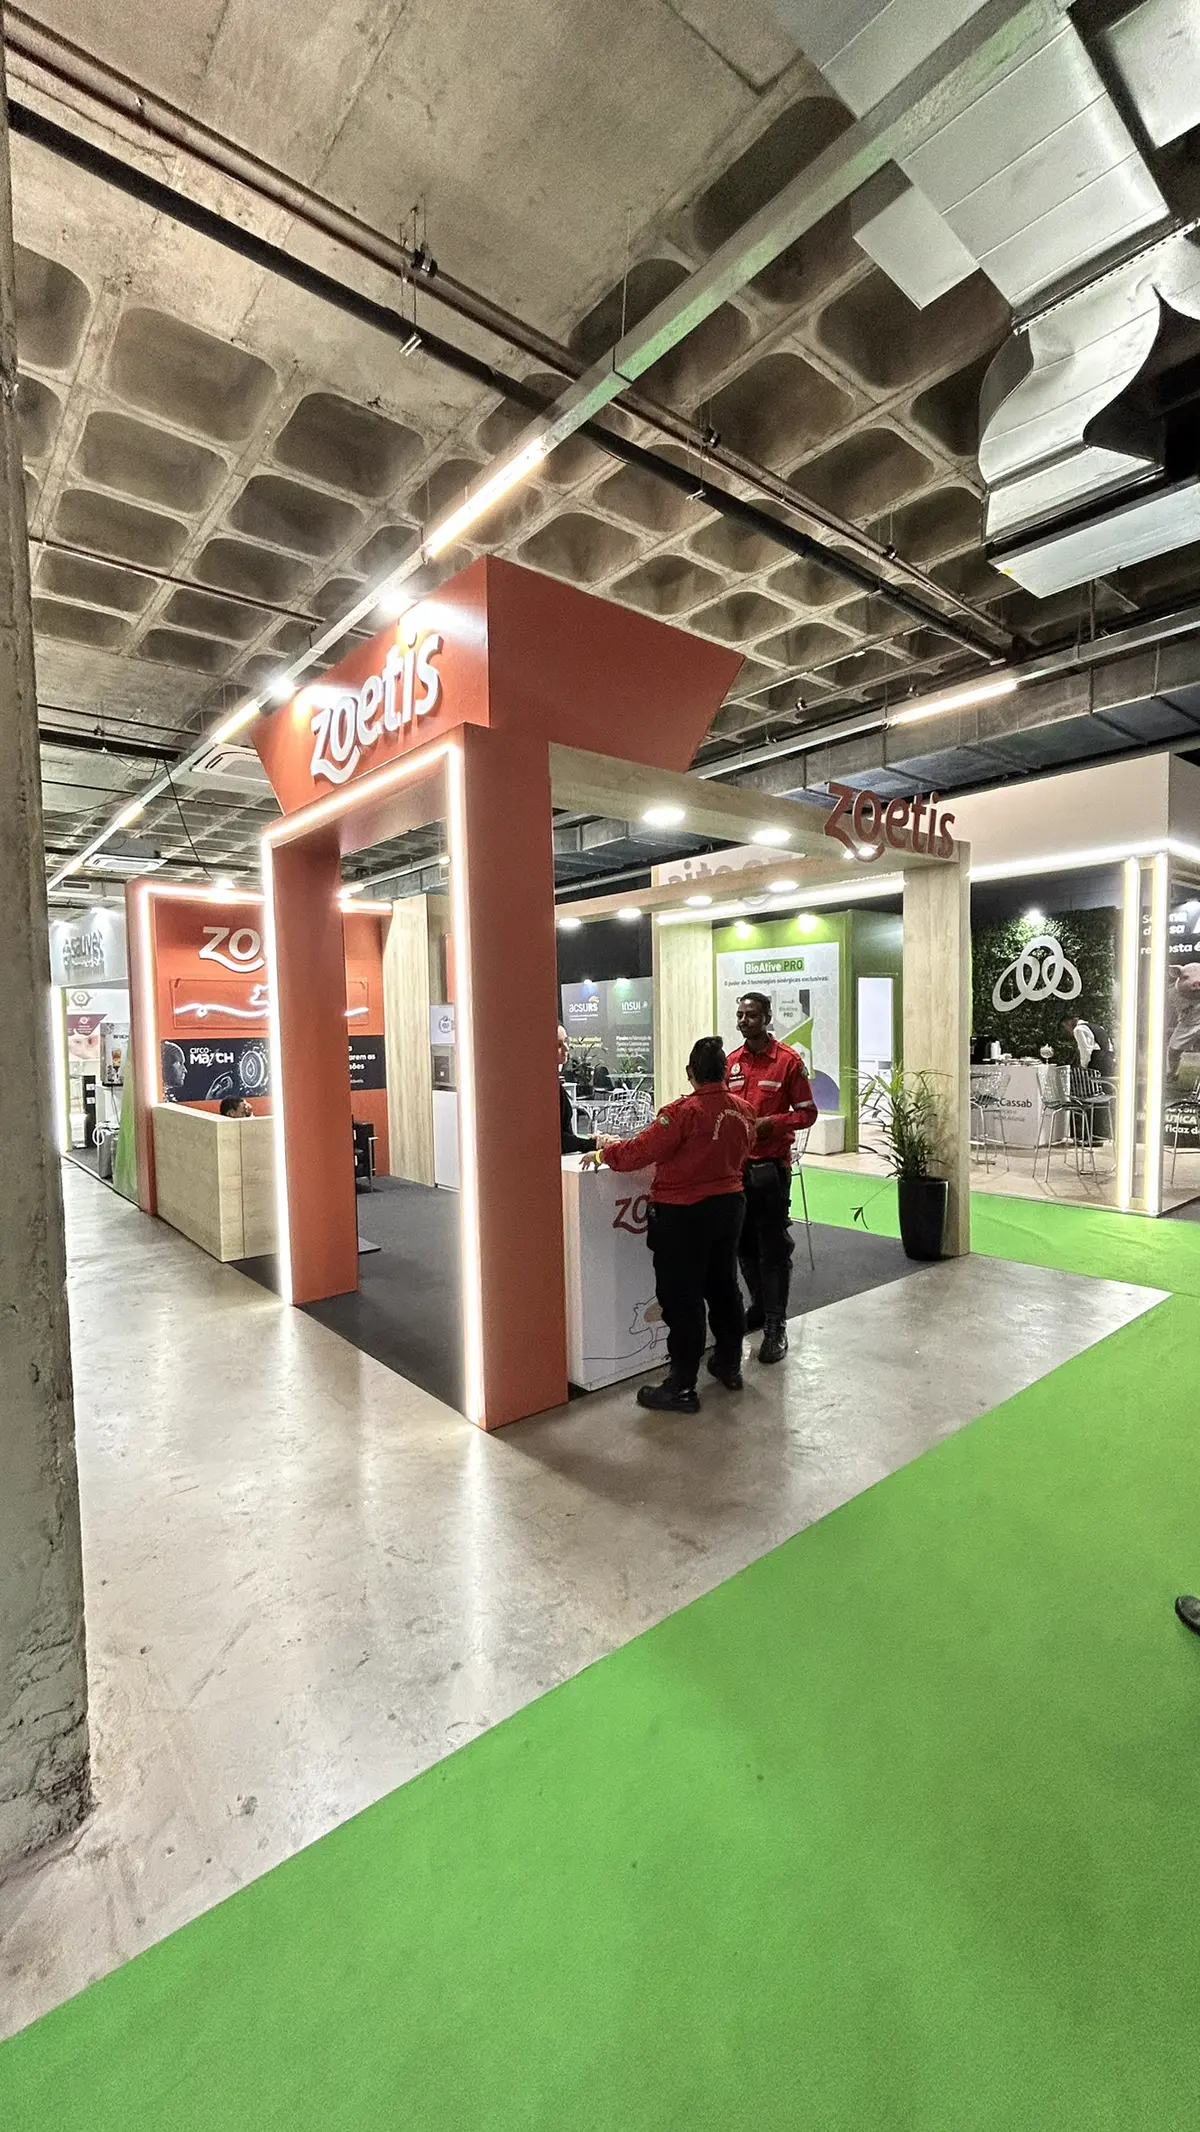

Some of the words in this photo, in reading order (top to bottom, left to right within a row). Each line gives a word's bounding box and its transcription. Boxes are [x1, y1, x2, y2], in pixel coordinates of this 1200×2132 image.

[310, 632, 444, 784] zoetis
[823, 781, 955, 863] zoetis
[198, 926, 265, 973] zo
[745, 961, 782, 974] BioAtive
[783, 959, 804, 971] PRO
[349, 1062, 365, 1070] sões
[999, 1098, 1033, 1108] Cassab
[1164, 1124, 1190, 1134] ficaz
[612, 1194, 650, 1234] zo
